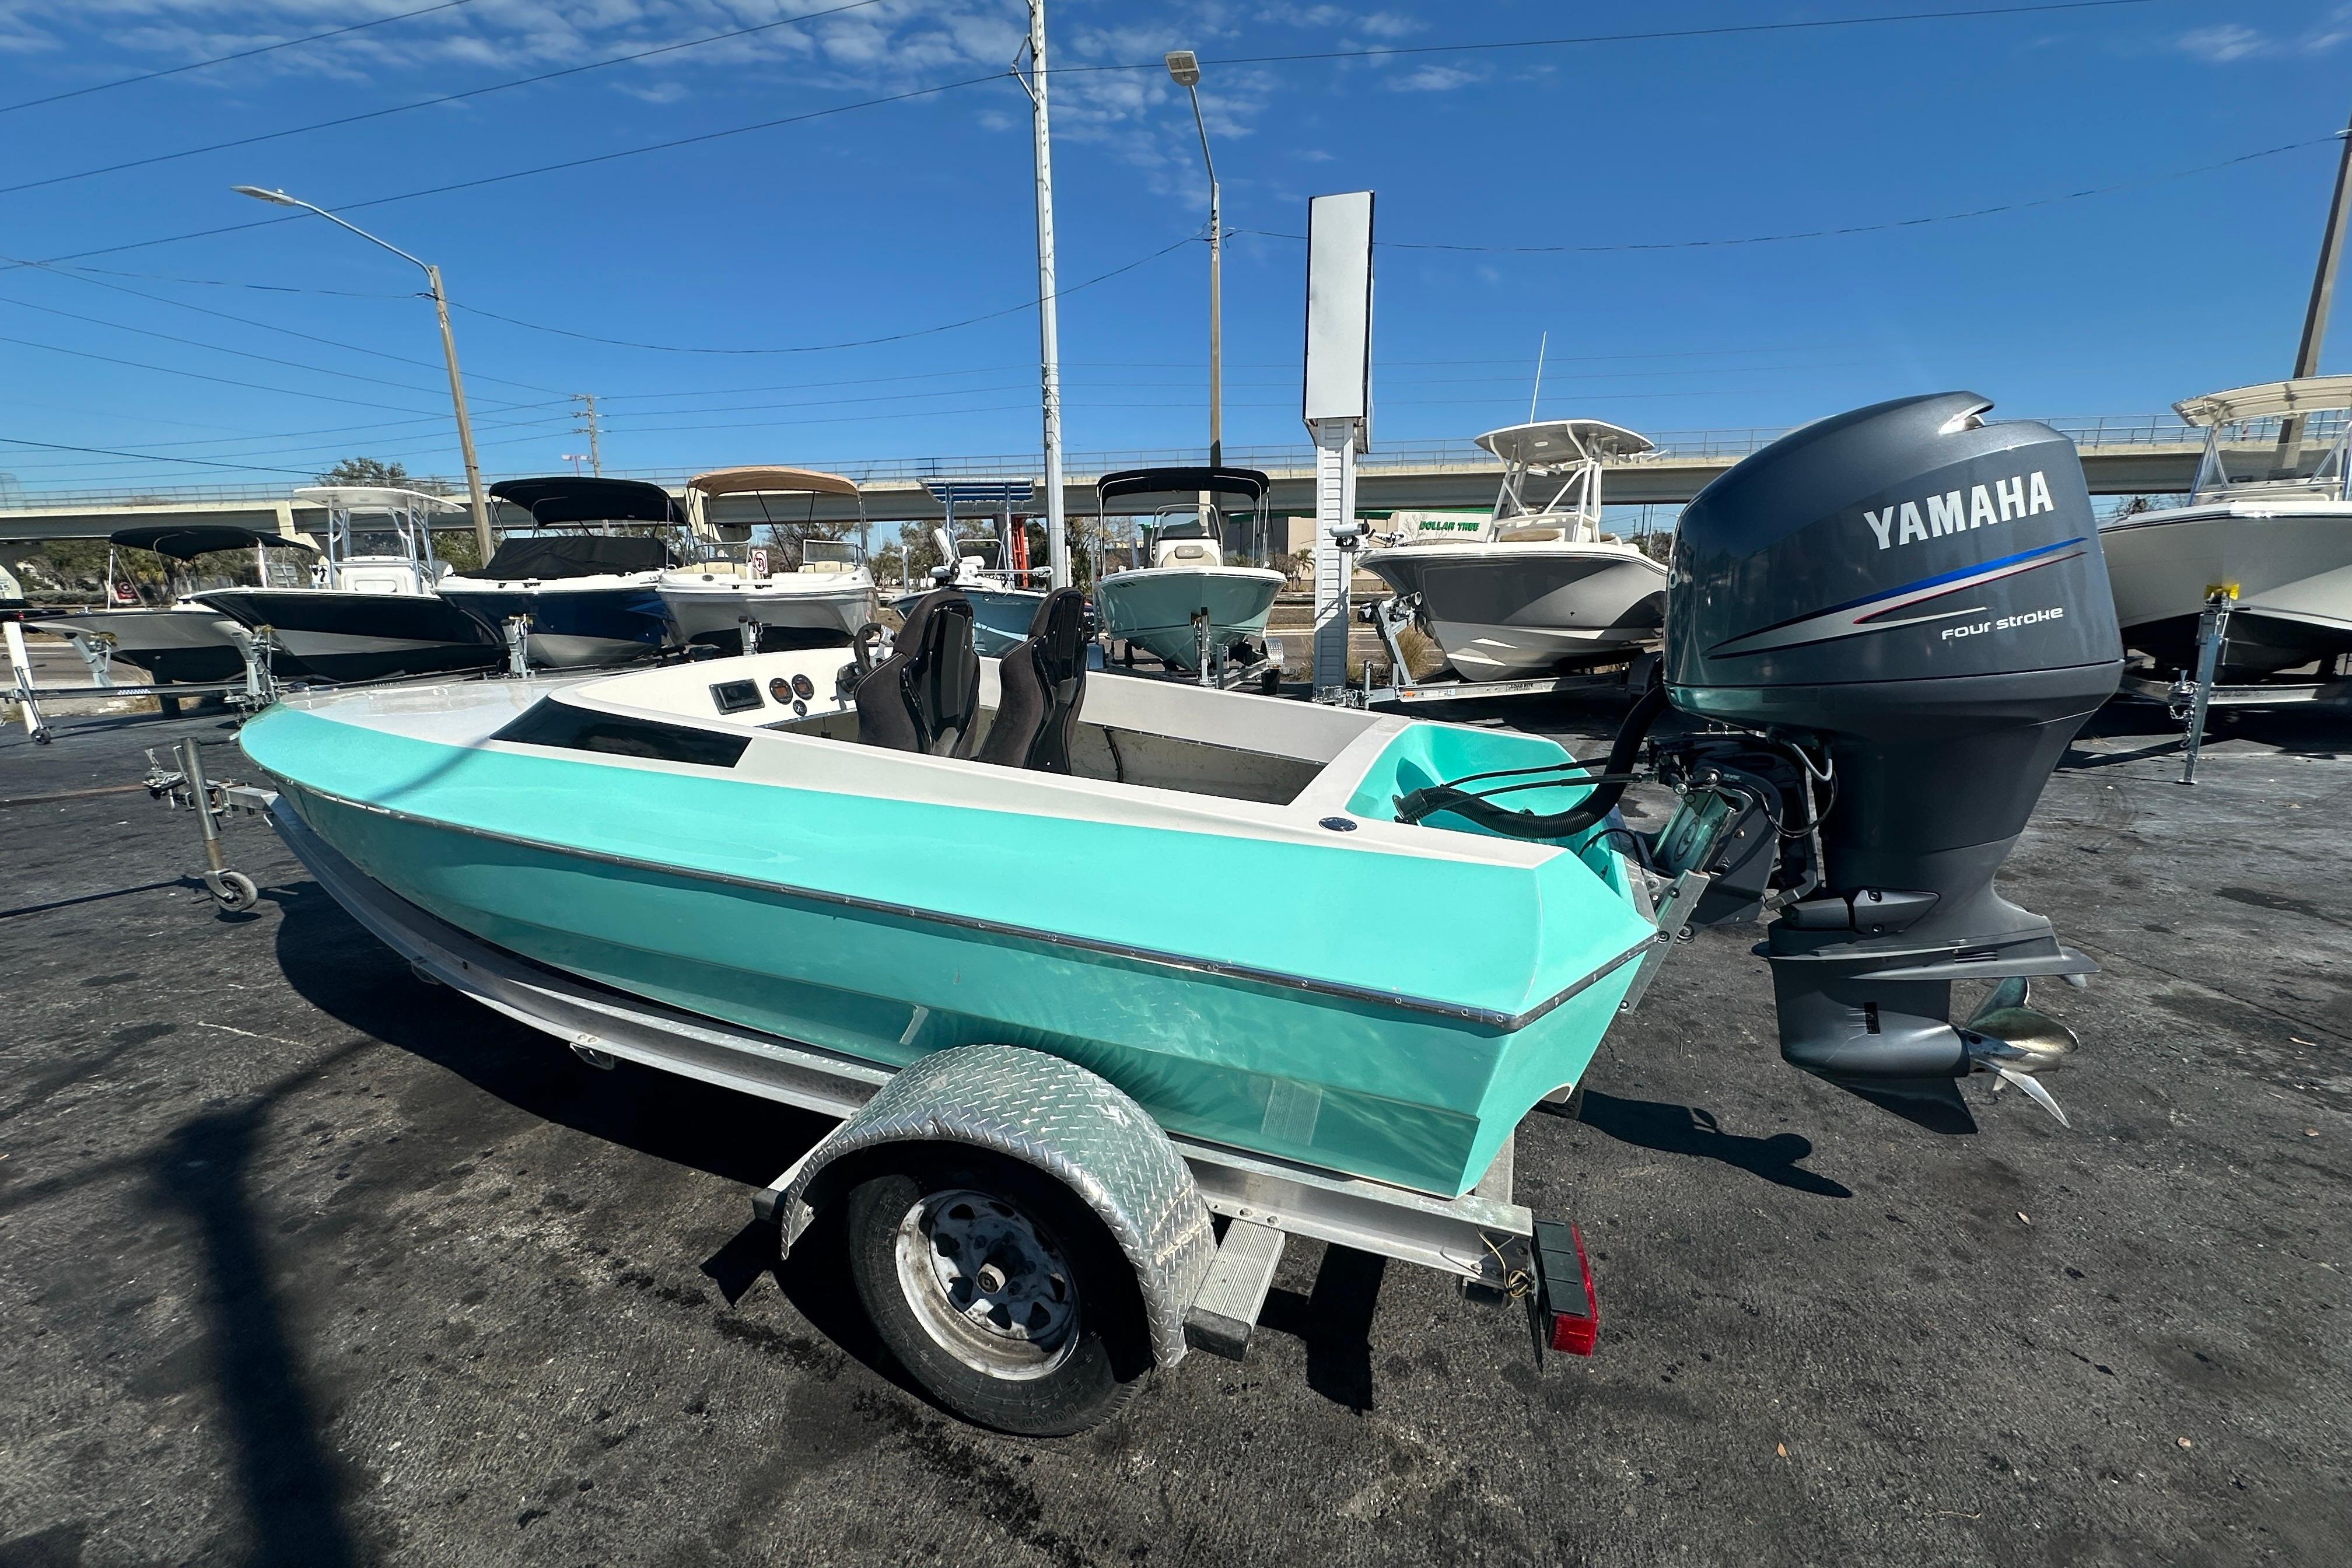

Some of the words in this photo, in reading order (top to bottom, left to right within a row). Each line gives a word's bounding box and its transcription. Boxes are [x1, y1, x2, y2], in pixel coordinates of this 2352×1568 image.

[1863, 471, 2054, 550] YAMAHA
[1419, 521, 1455, 531] DOLLAR
[1457, 522, 1480, 531] TREE
[1019, 1402, 1079, 1429] LOAD
